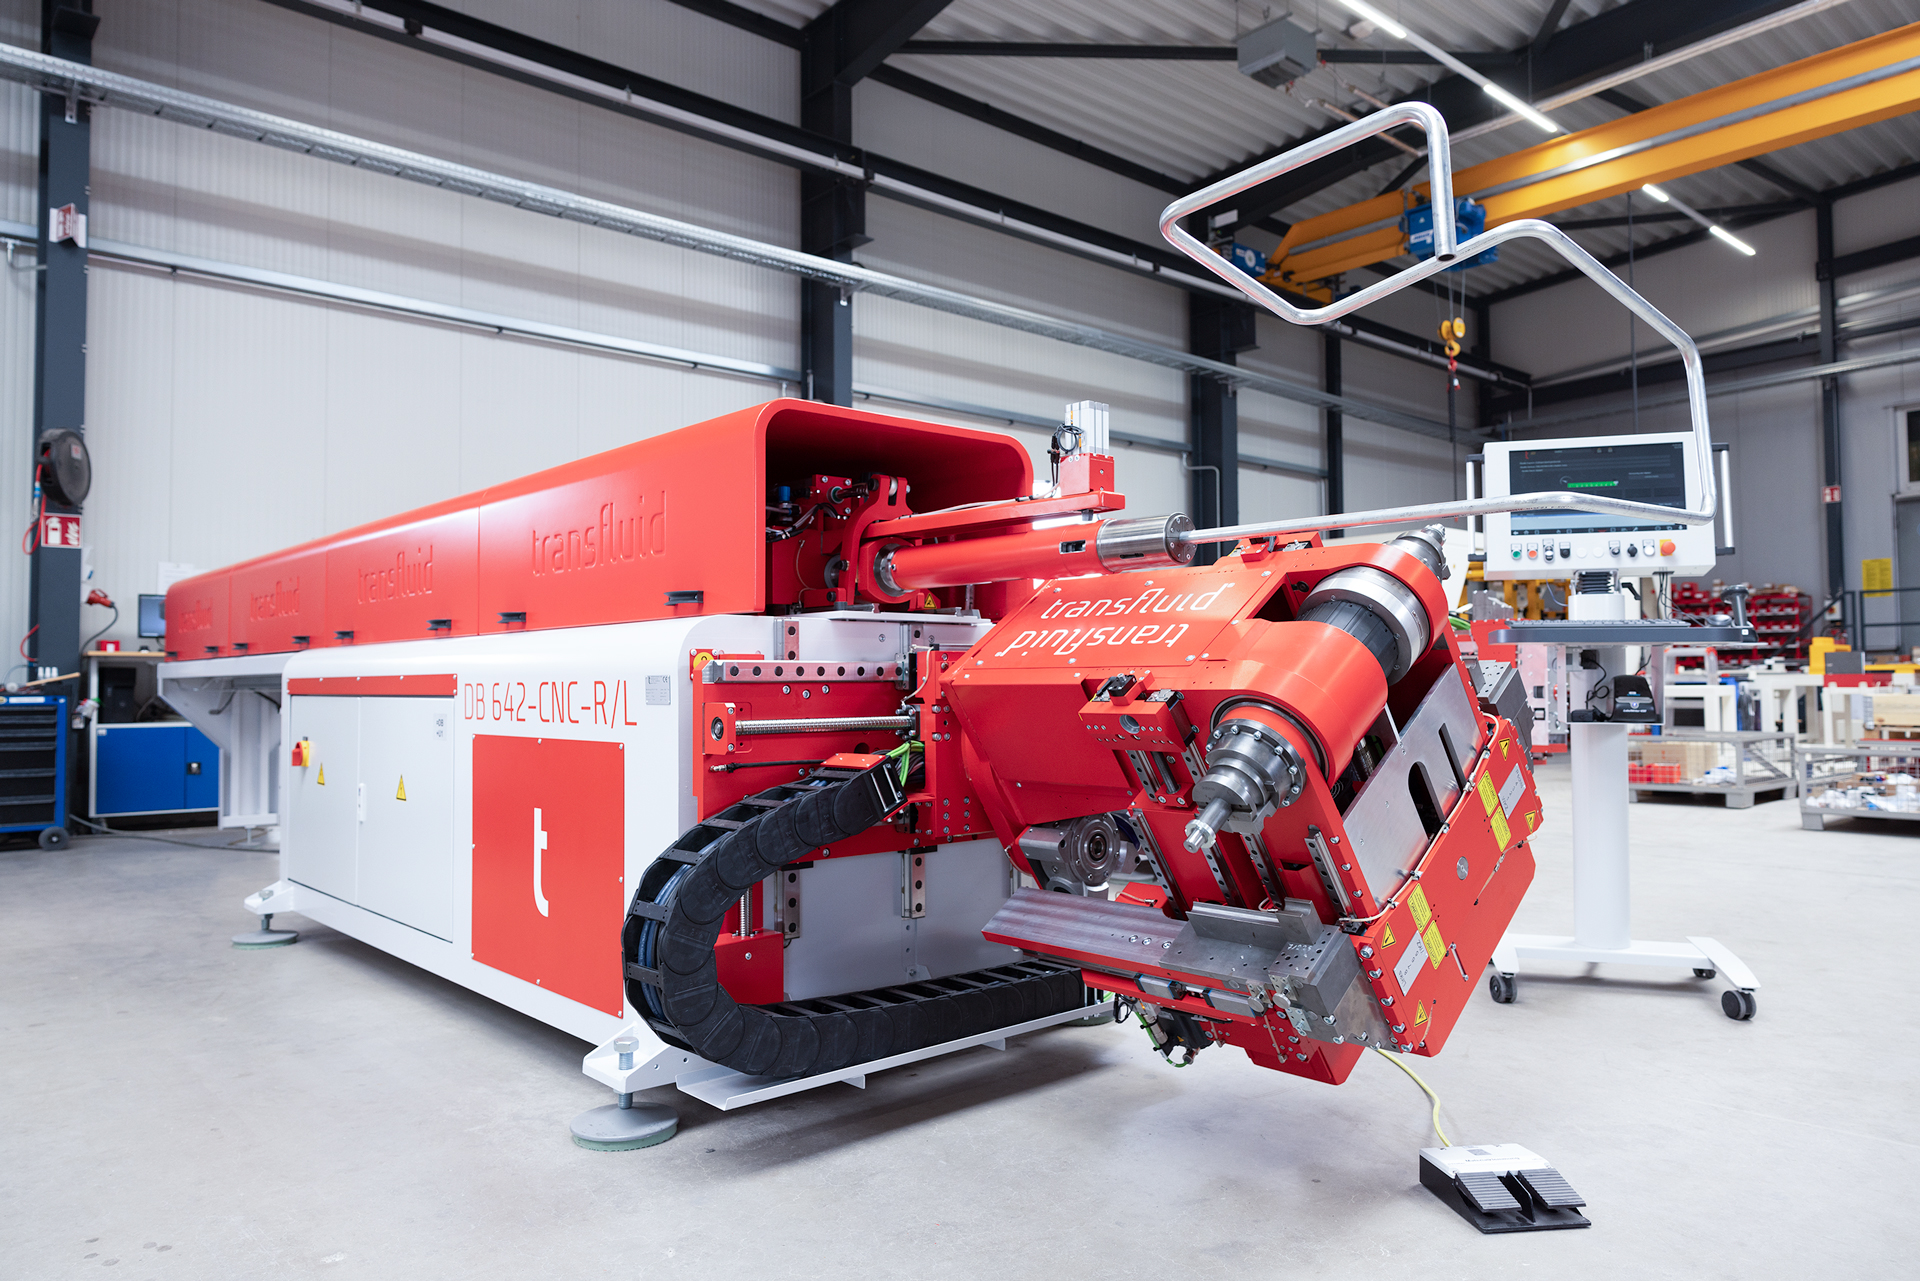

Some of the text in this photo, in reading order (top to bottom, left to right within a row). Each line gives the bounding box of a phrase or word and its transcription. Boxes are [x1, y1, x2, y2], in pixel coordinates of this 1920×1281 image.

[531, 490, 667, 577] transfluid
[249, 577, 300, 623] transfluid
[357, 545, 434, 605] transfluid
[1041, 583, 1231, 619] transfluid
[464, 682, 486, 721] DB
[492, 680, 638, 729] 642-CNC-R/L
[533, 807, 549, 918] t
